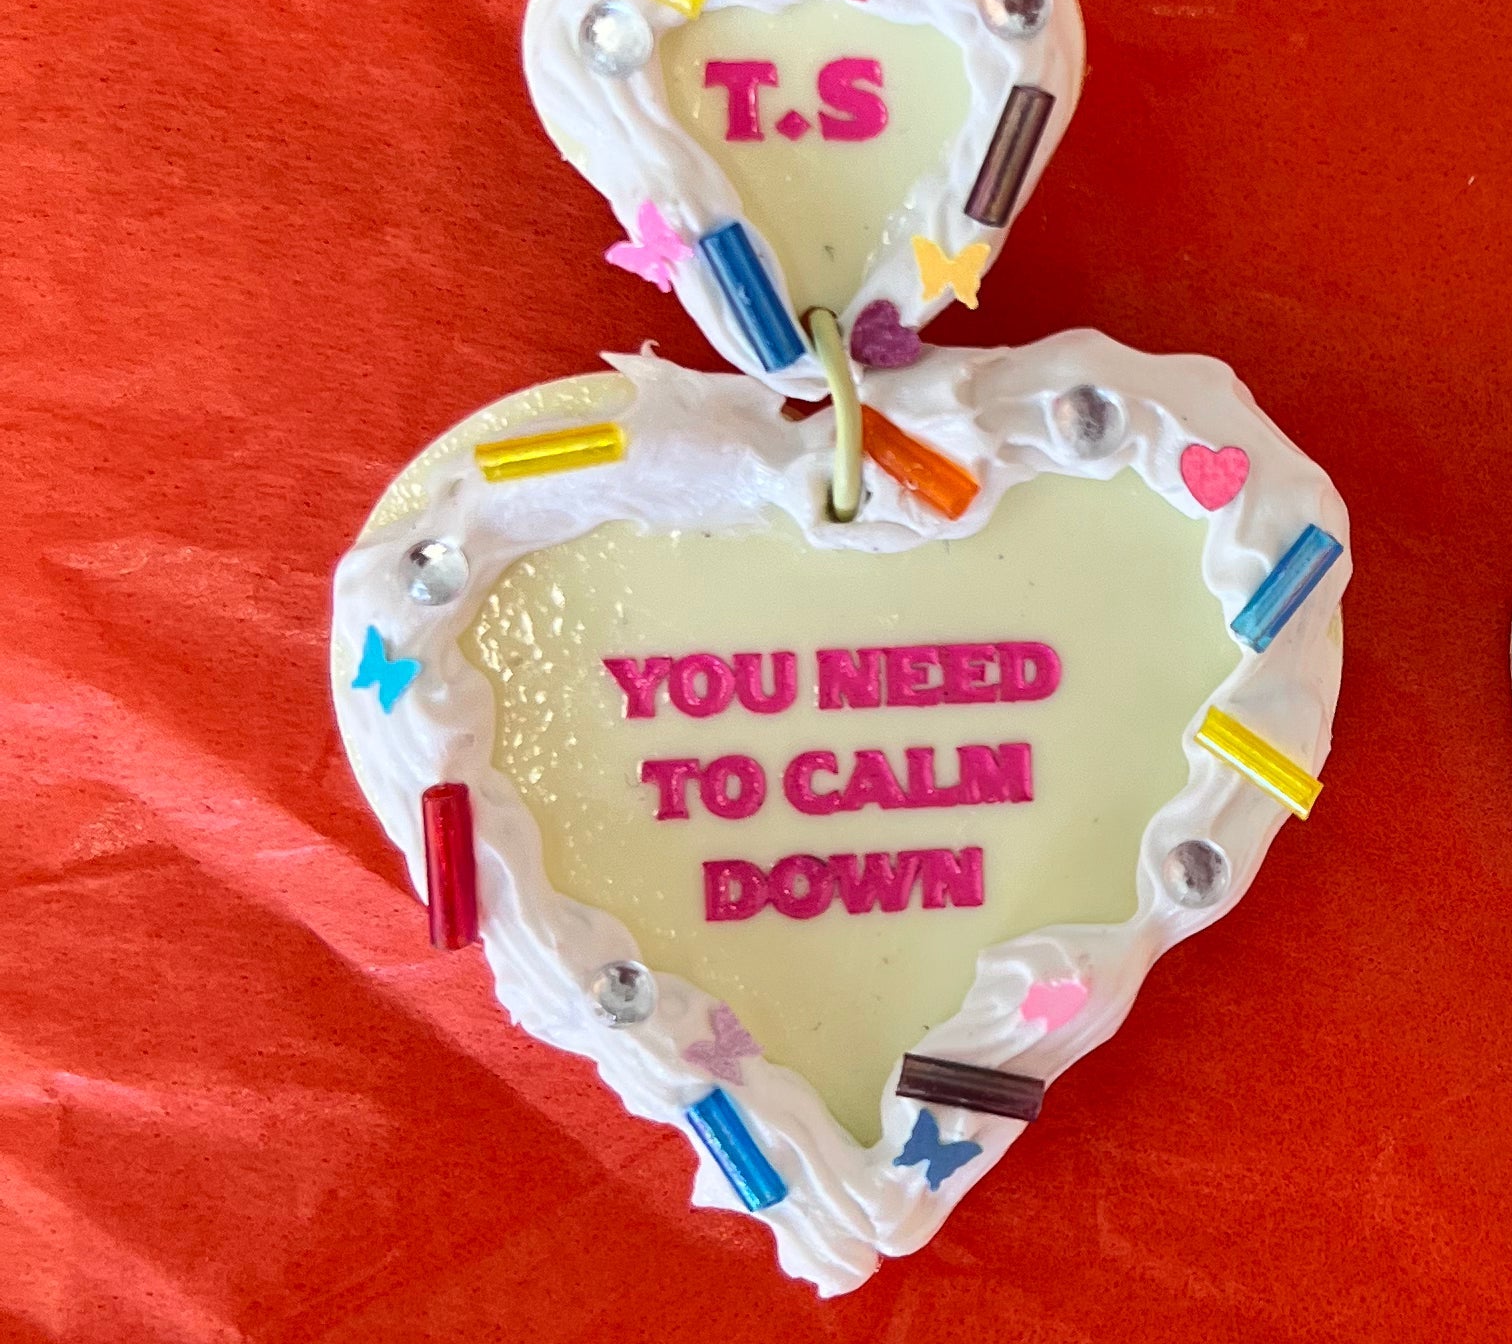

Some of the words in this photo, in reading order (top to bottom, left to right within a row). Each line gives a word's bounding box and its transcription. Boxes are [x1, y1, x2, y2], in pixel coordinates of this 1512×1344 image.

[703, 57, 889, 142] T.S
[603, 650, 798, 720] YOU
[815, 641, 1062, 711] NEED
[641, 753, 767, 821] TO
[782, 742, 1034, 817] CALM
[702, 846, 985, 923] DOWN
